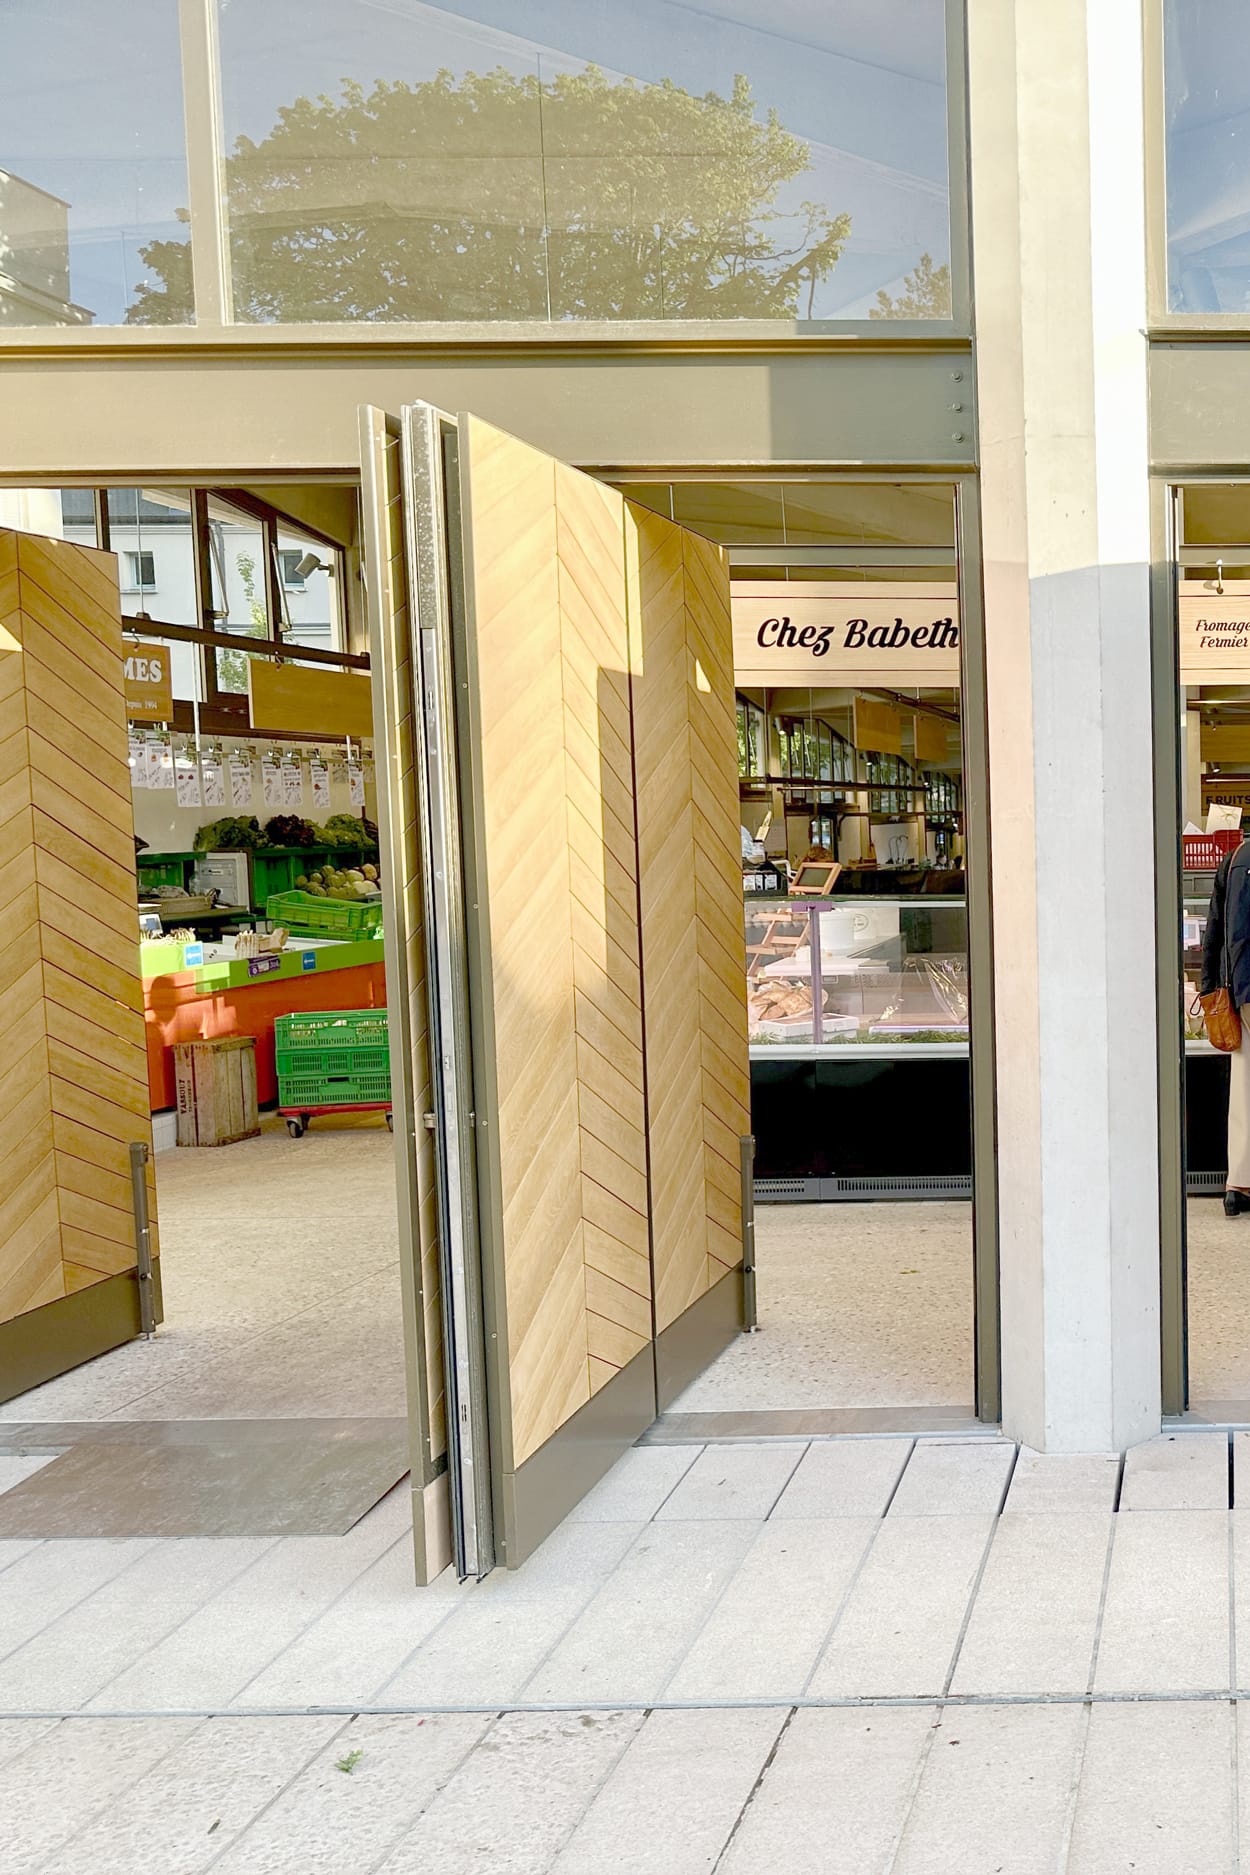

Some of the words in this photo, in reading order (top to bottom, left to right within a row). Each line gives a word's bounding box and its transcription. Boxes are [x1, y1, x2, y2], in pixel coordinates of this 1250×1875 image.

[757, 616, 835, 657] Chez
[843, 617, 959, 648] Babeth
[1200, 635, 1248, 648] Fermier
[1206, 795, 1250, 805] FRUITS
